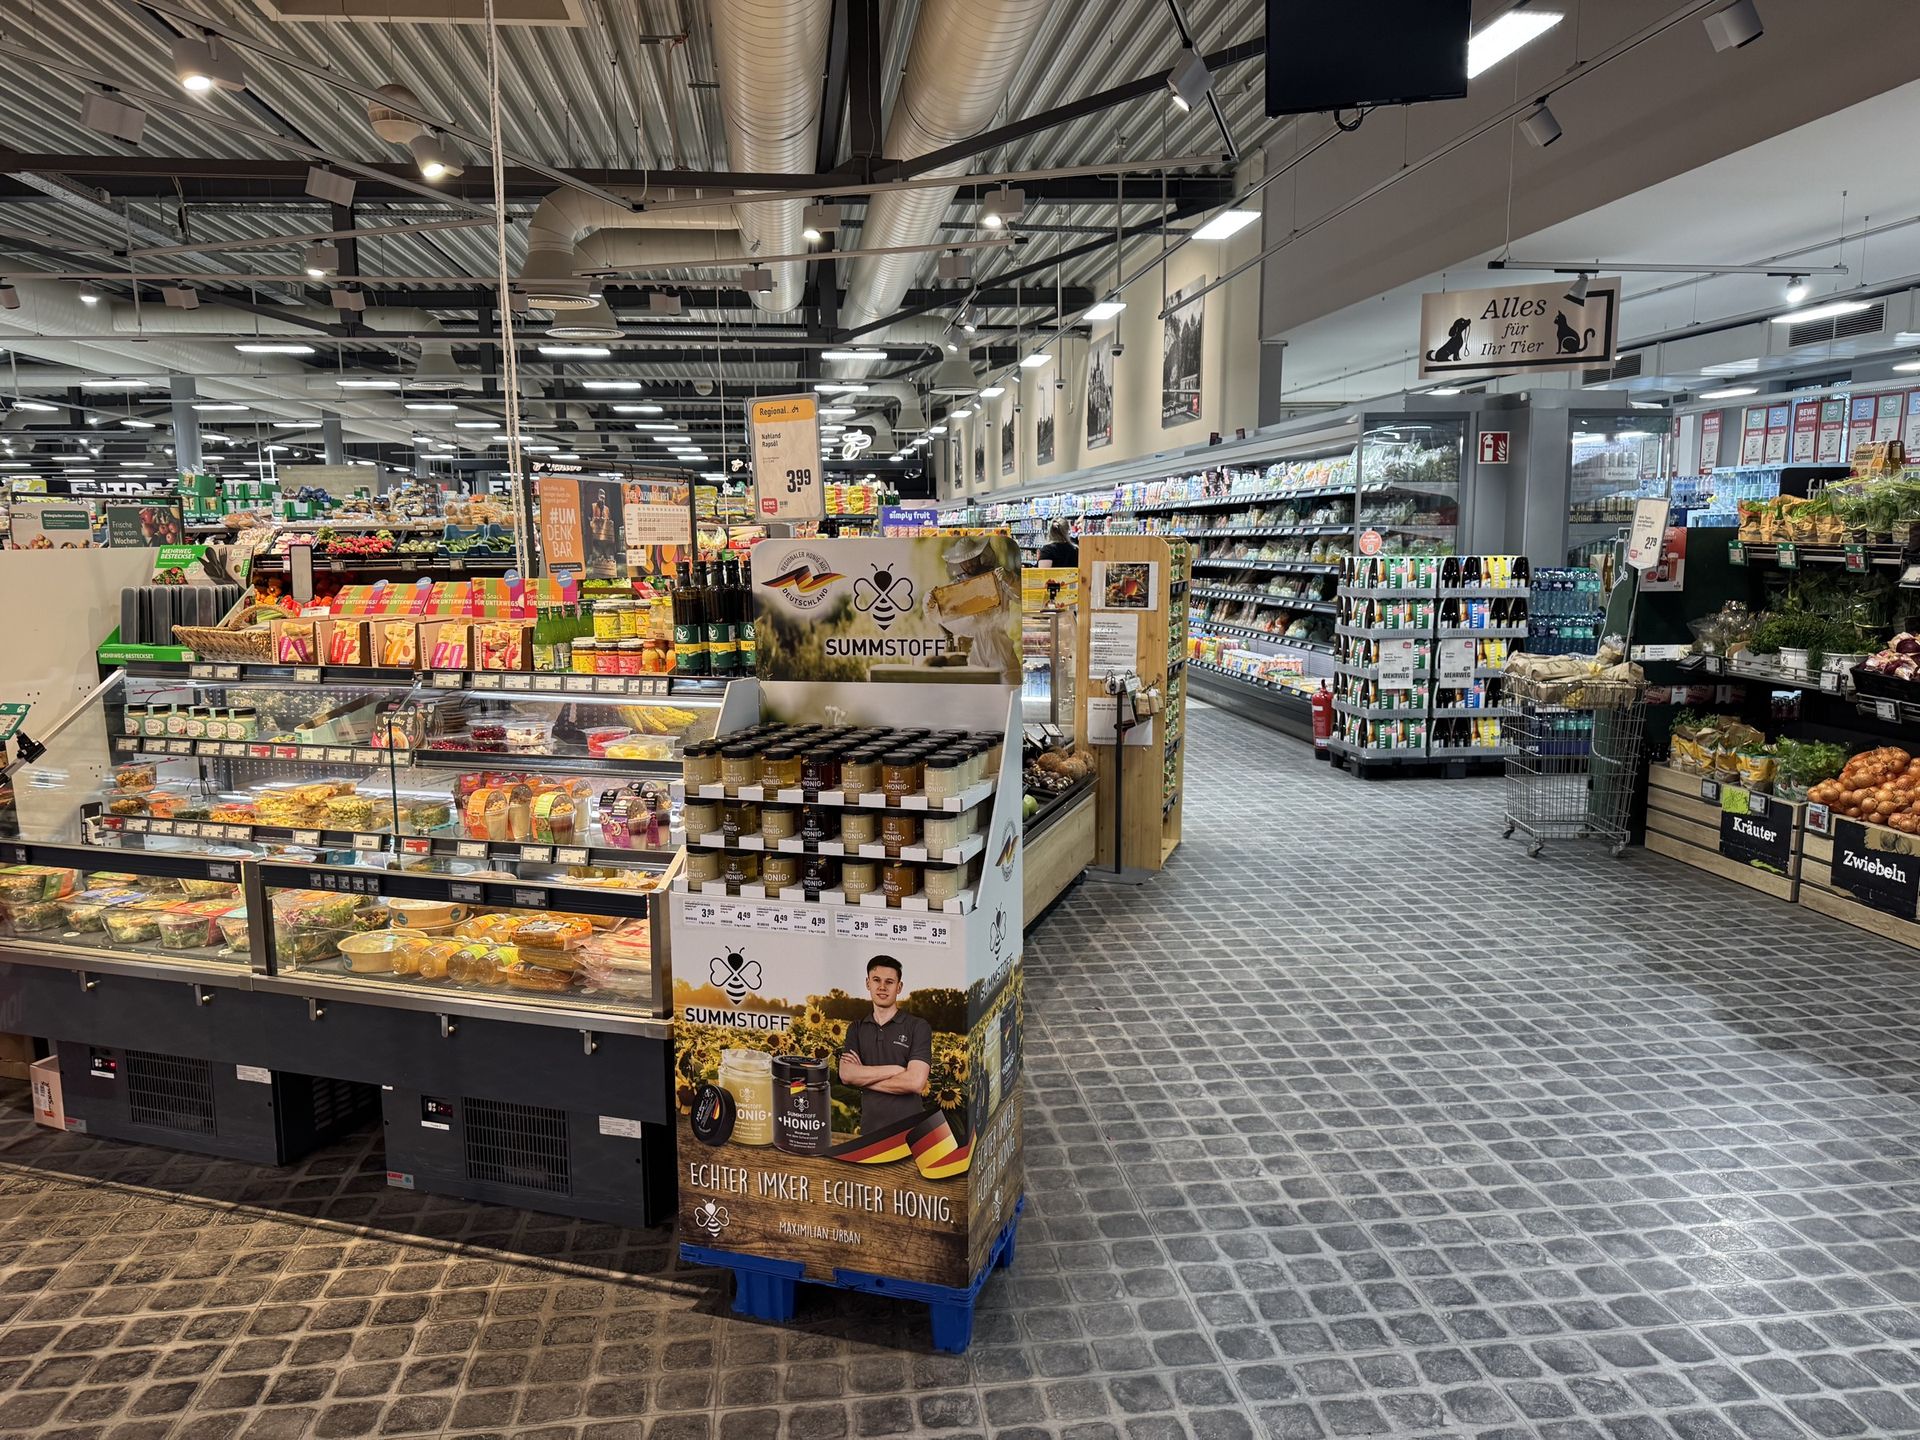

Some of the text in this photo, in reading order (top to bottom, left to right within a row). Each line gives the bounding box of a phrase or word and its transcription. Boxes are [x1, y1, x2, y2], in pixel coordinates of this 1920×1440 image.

[1480, 297, 1547, 320] Alles
[1501, 322, 1529, 340] für
[1480, 340, 1545, 356] Ihr Tier
[786, 469, 811, 493] 3.99
[549, 508, 576, 525] #UM
[889, 510, 931, 520] simply fruit
[112, 521, 133, 529] Frische
[546, 524, 574, 541] DENK
[114, 537, 139, 545] Wochen-
[1644, 536, 1658, 549] 2.79
[553, 542, 574, 558] BAR
[781, 551, 804, 572] REGIONALER
[806, 552, 821, 563] HONIG
[782, 587, 829, 607] DEUTSCHLAND
[825, 639, 946, 657] SUMMSTOFF
[803, 830, 822, 838] HONIG
[1733, 816, 1777, 843] Kräuter
[1843, 850, 1907, 883] Zwiebeln
[764, 872, 788, 882] HONIG
[701, 908, 947, 937] 3.99 4.49 4.49 4.99 3.99 6.99 3.99
[685, 1008, 790, 1031] SUMMSTOFF
[737, 1109, 767, 1121] ONIG
[787, 1110, 816, 1119] SUMMSTOFF
[783, 1116, 820, 1131] HONIG
[690, 1163, 954, 1224] ECHTER IMKER. ECHTER HONIG.
[779, 1222, 861, 1245] MAXIMILIAN URBAN
